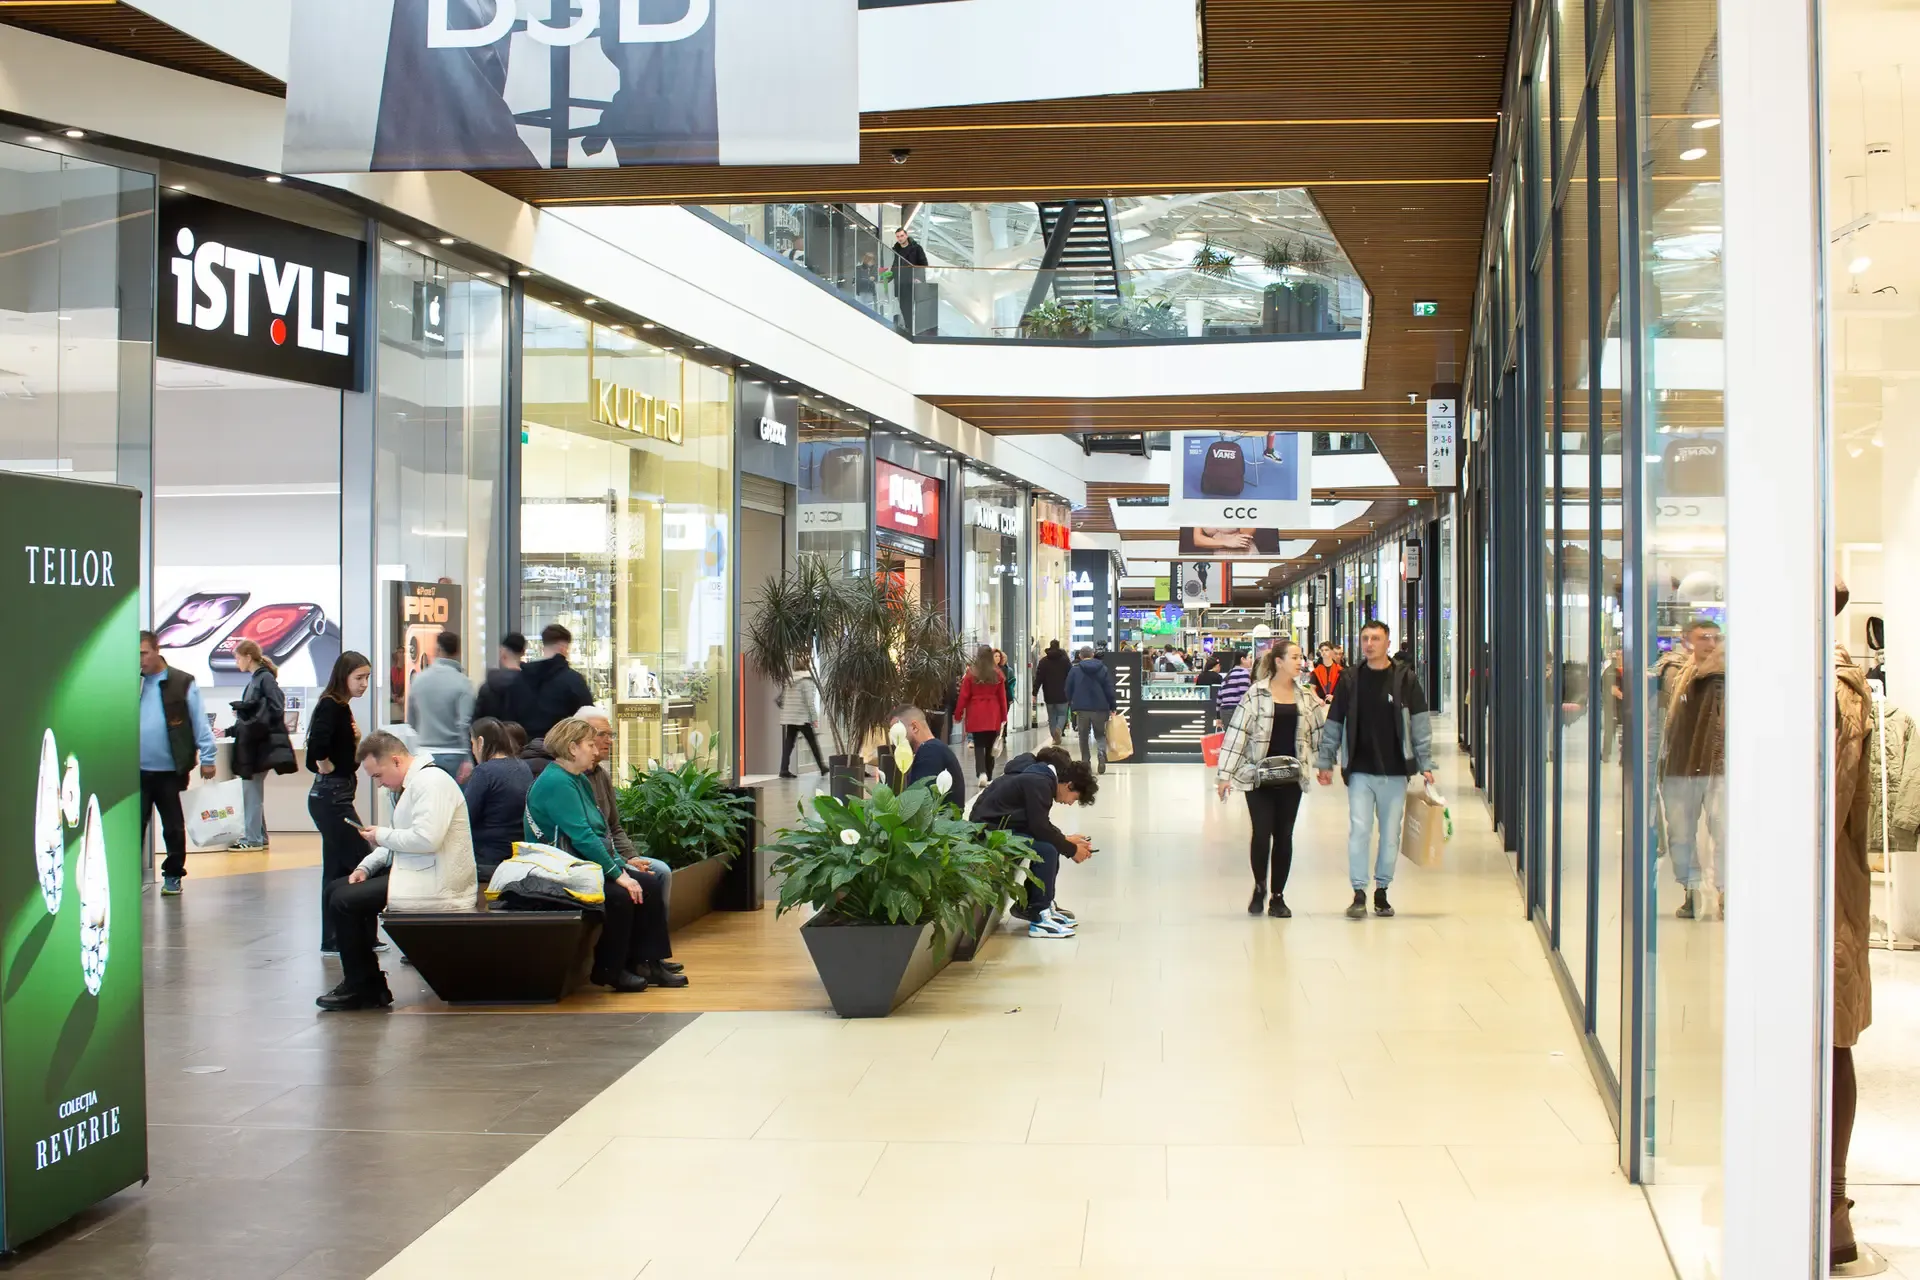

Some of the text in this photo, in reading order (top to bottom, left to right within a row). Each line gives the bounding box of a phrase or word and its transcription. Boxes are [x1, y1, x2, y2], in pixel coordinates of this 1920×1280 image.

[171, 226, 350, 356] iSTYLE
[593, 378, 683, 445] KULTHO
[1213, 449, 1236, 460] VANS
[1223, 507, 1258, 519] CCC
[25, 546, 115, 587] TEILOR
[404, 596, 449, 623] PRO
[35, 1105, 121, 1171] REVERIE
